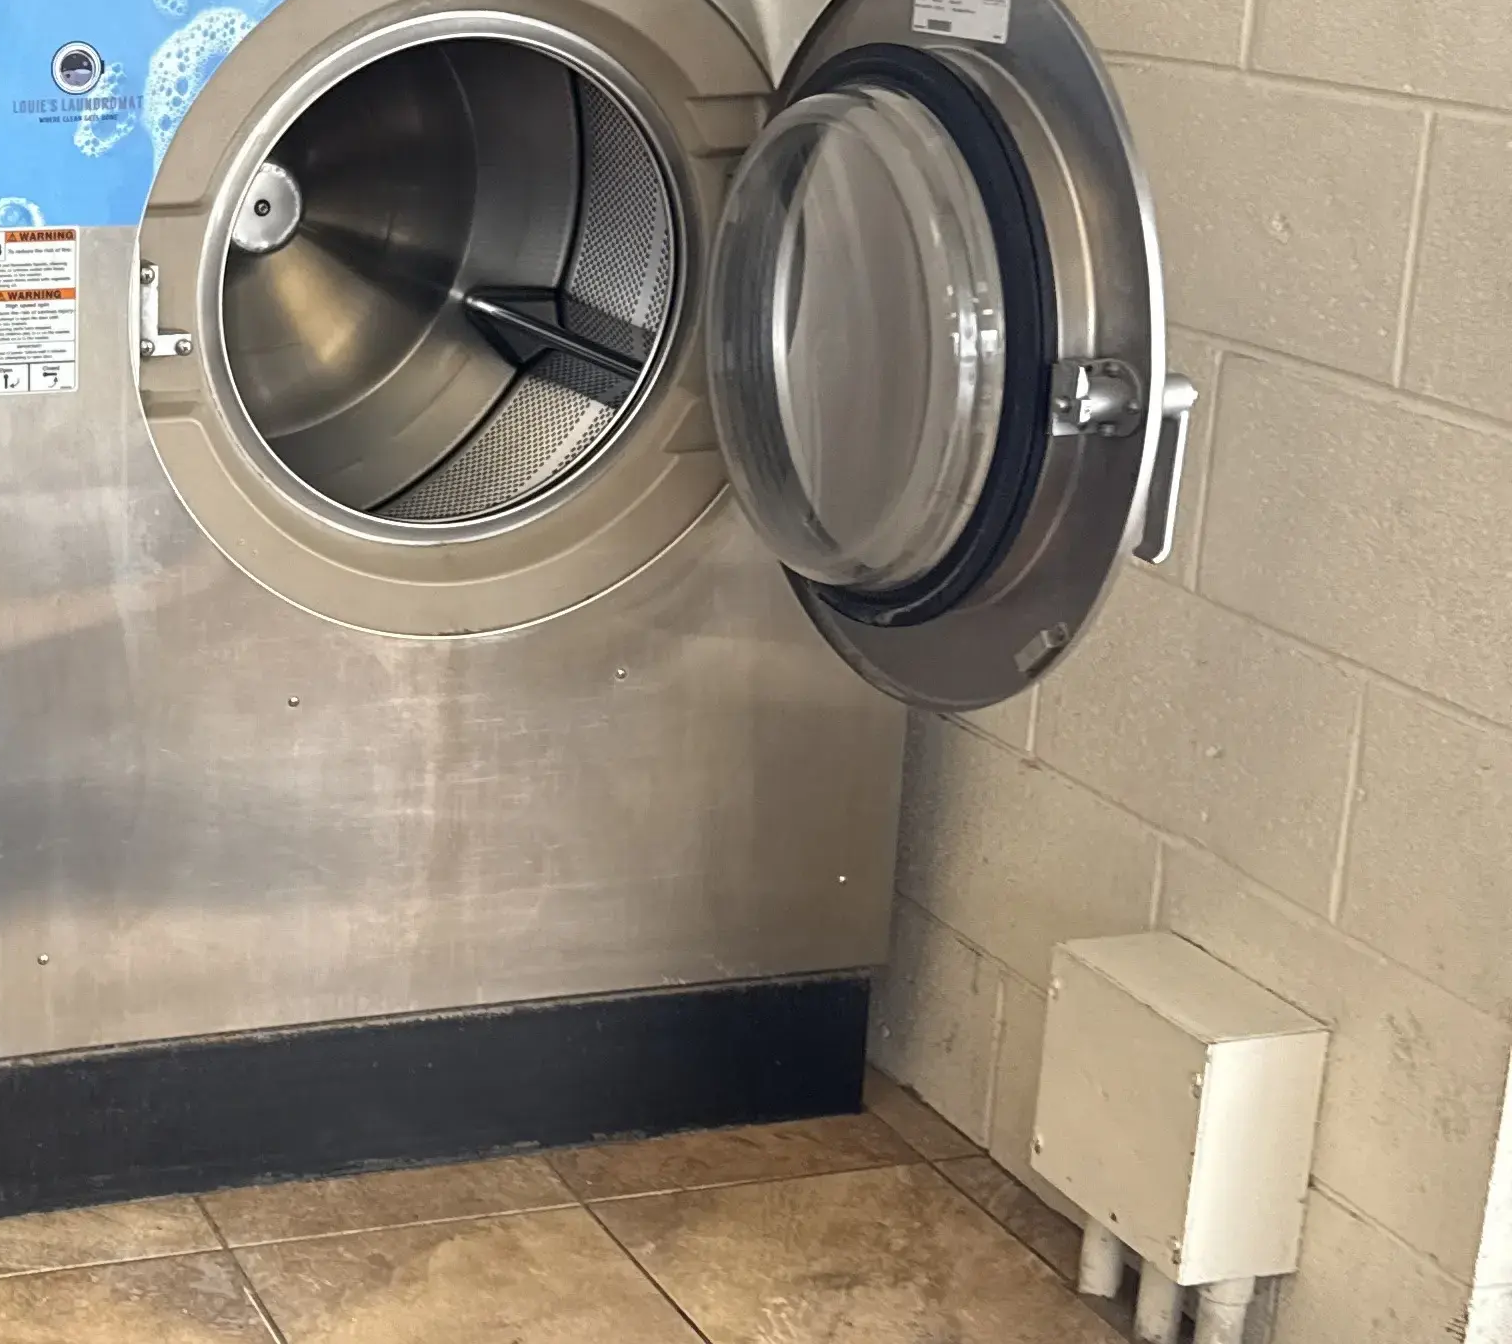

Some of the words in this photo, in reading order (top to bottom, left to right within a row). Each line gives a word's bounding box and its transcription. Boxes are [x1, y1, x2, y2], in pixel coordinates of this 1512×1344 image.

[12, 98, 58, 114] LOUIE'S
[61, 95, 144, 111] LAUNDROMAT
[19, 230, 74, 242] WARNING
[7, 290, 62, 301] WARNING
